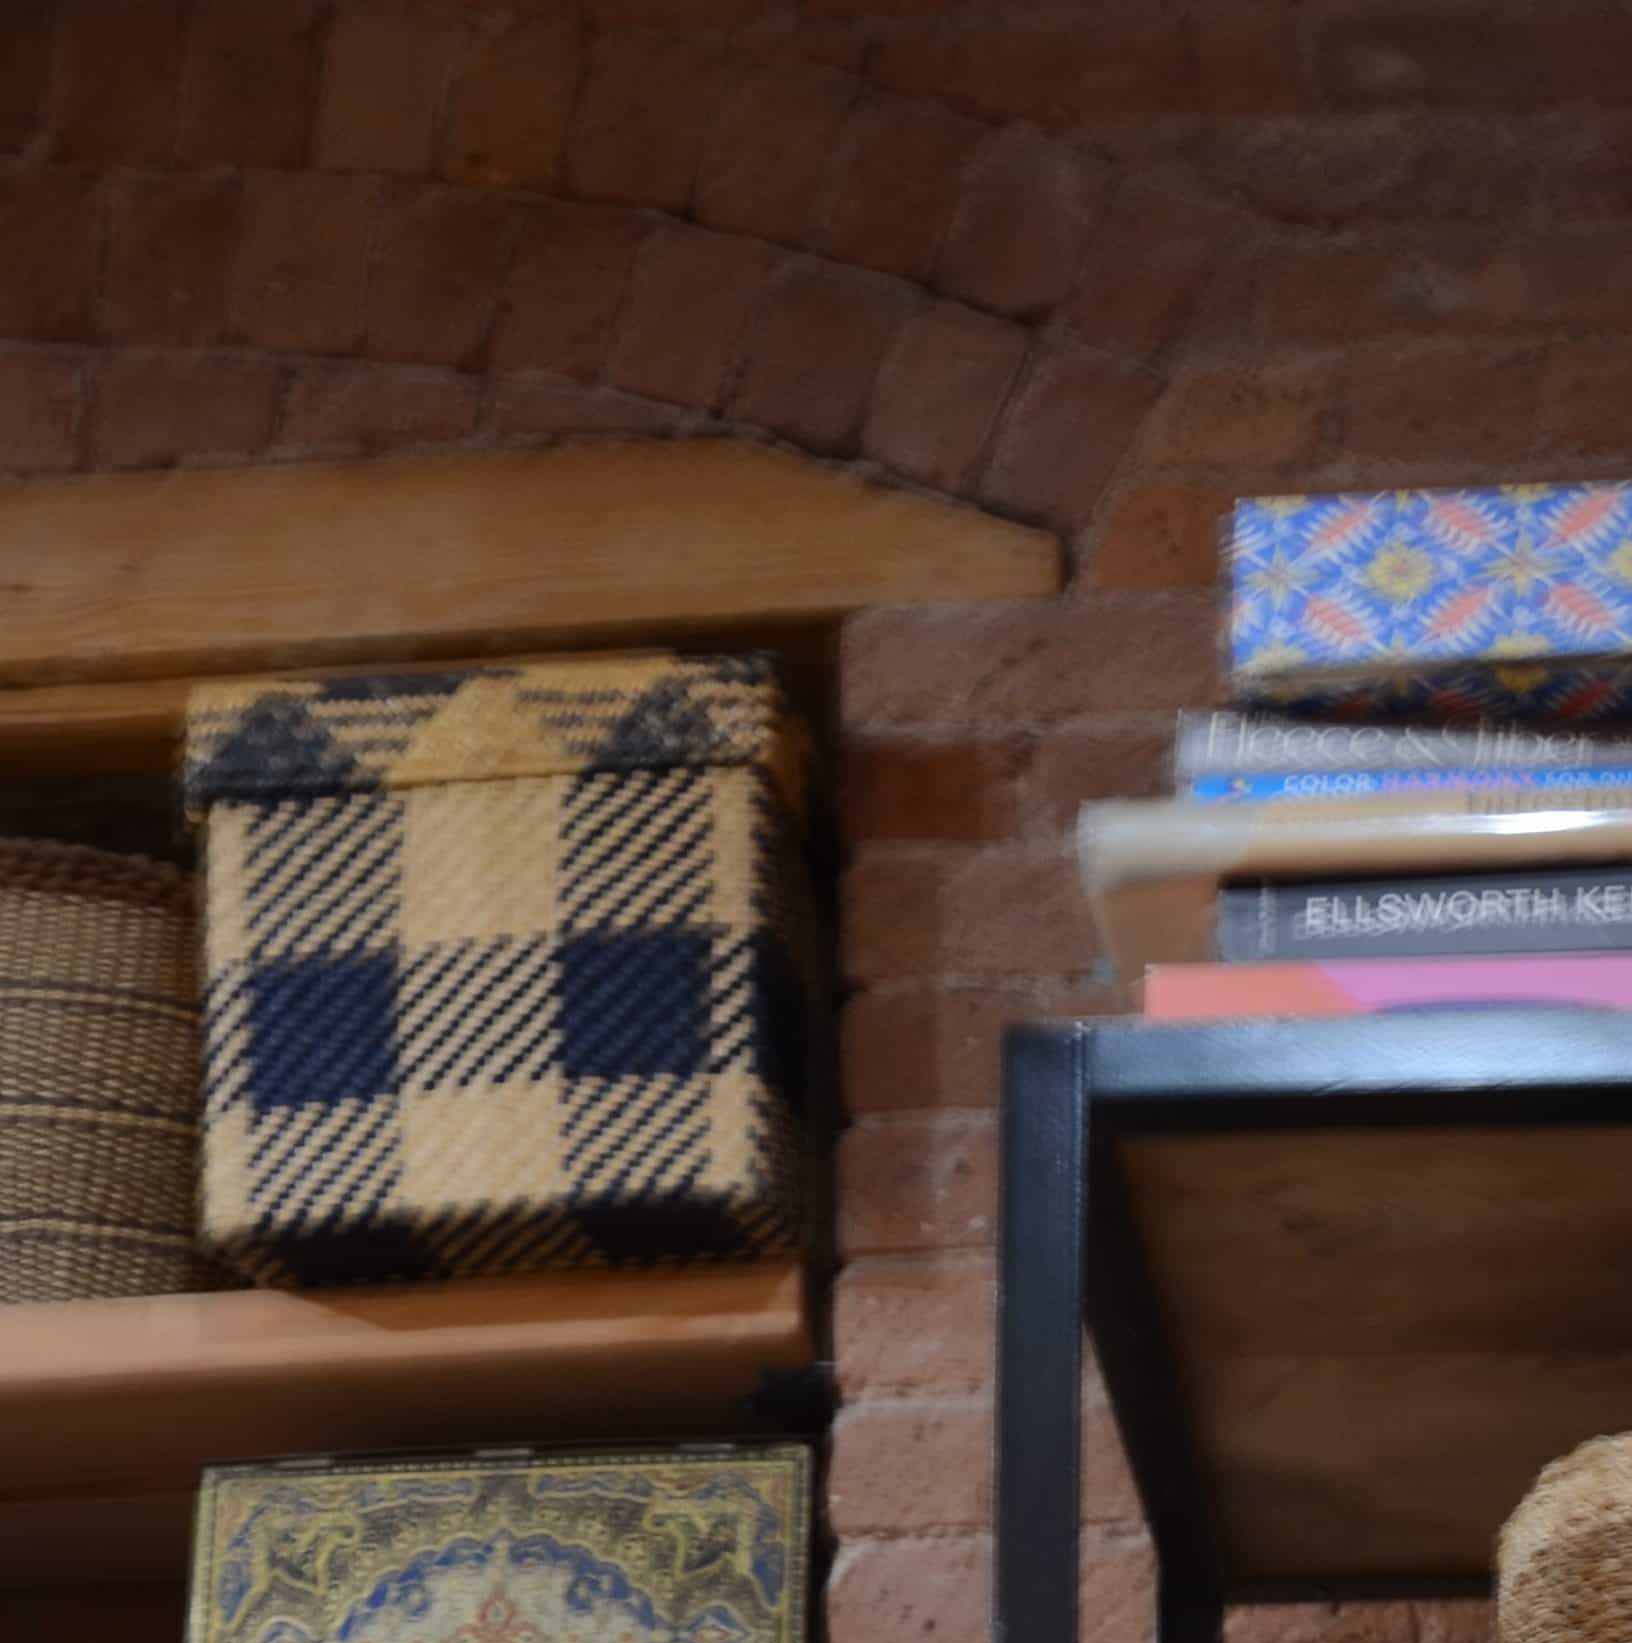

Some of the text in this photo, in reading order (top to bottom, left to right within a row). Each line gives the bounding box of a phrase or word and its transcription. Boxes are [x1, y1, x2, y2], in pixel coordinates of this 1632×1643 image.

[1205, 711, 1386, 768] Fleece
[1400, 724, 1440, 767] &
[1282, 772, 1376, 796] COLOR
[1299, 887, 1560, 937] ELLSWORTH
